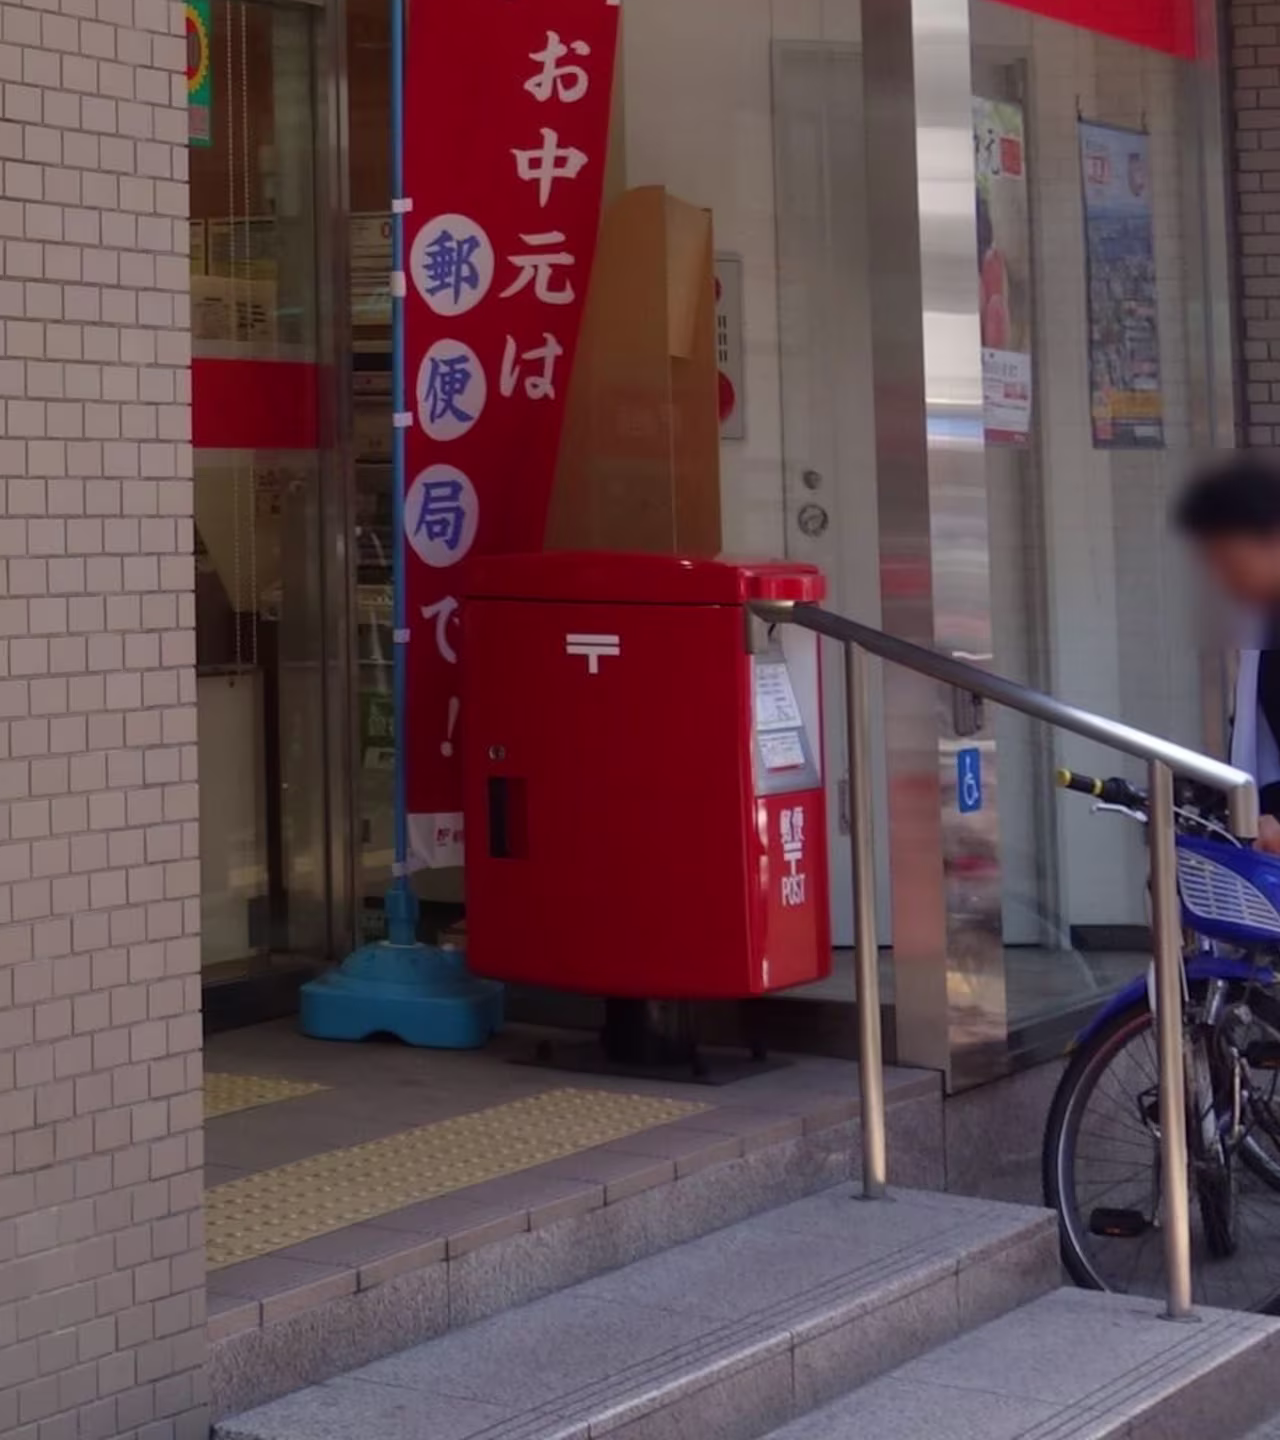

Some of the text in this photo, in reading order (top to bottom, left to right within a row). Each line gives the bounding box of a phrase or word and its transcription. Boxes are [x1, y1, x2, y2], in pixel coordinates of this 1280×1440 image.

[500, 29, 592, 402] お中元は
[781, 873, 806, 908] POST
